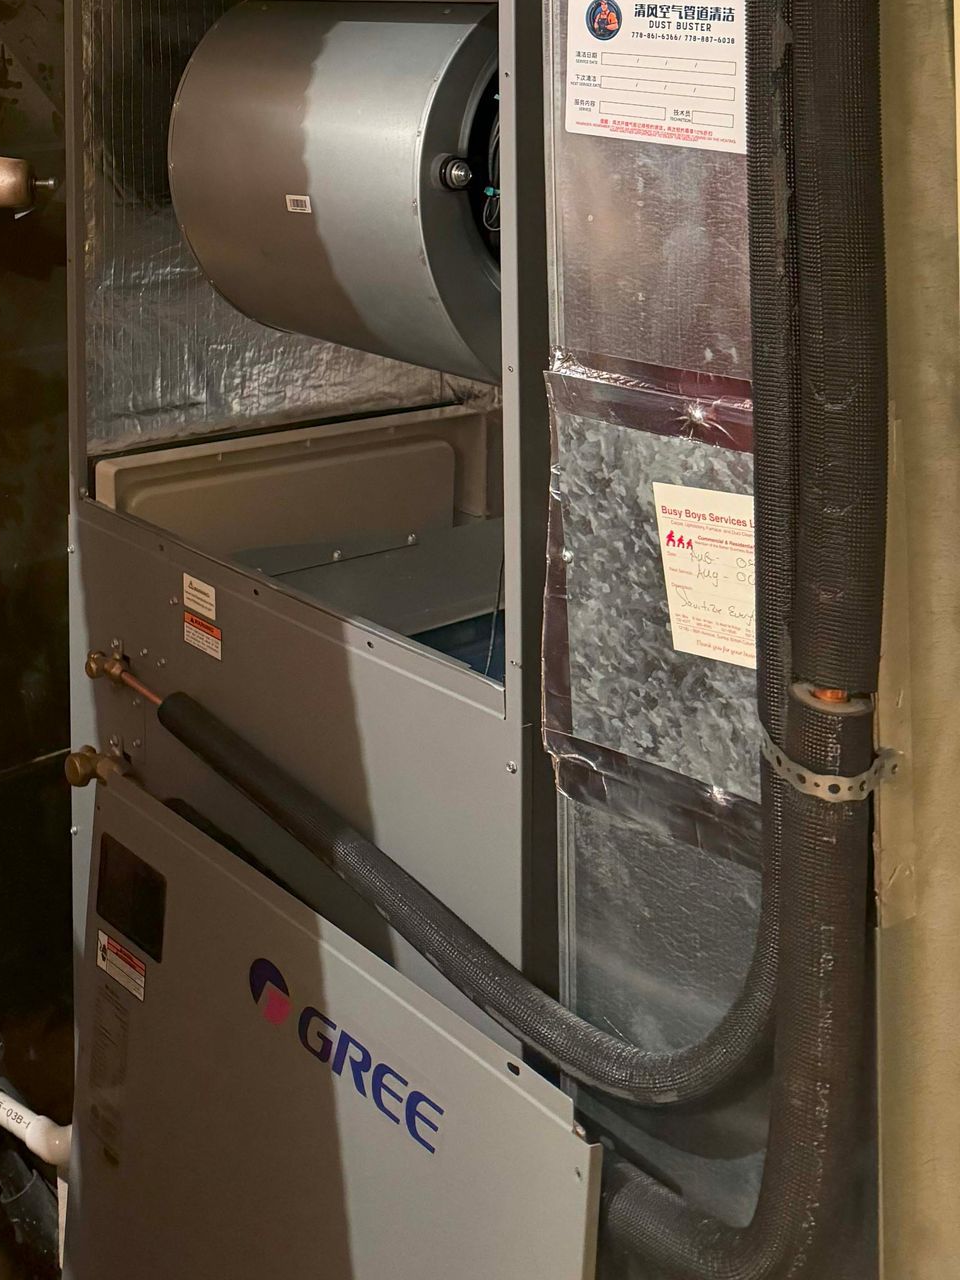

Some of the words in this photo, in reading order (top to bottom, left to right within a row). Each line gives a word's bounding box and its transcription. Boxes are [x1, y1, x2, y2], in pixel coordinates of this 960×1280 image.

[634, 4, 735, 22] 清风空气管道清洁
[649, 20, 672, 30] DUST
[676, 22, 712, 32] BUSTER
[673, 109, 690, 117] 技术员
[662, 506, 682, 518] Busy
[684, 509, 706, 521] Boys
[708, 512, 747, 527] Services
[698, 536, 724, 544] Commercial
[298, 1006, 445, 1154] GREE
